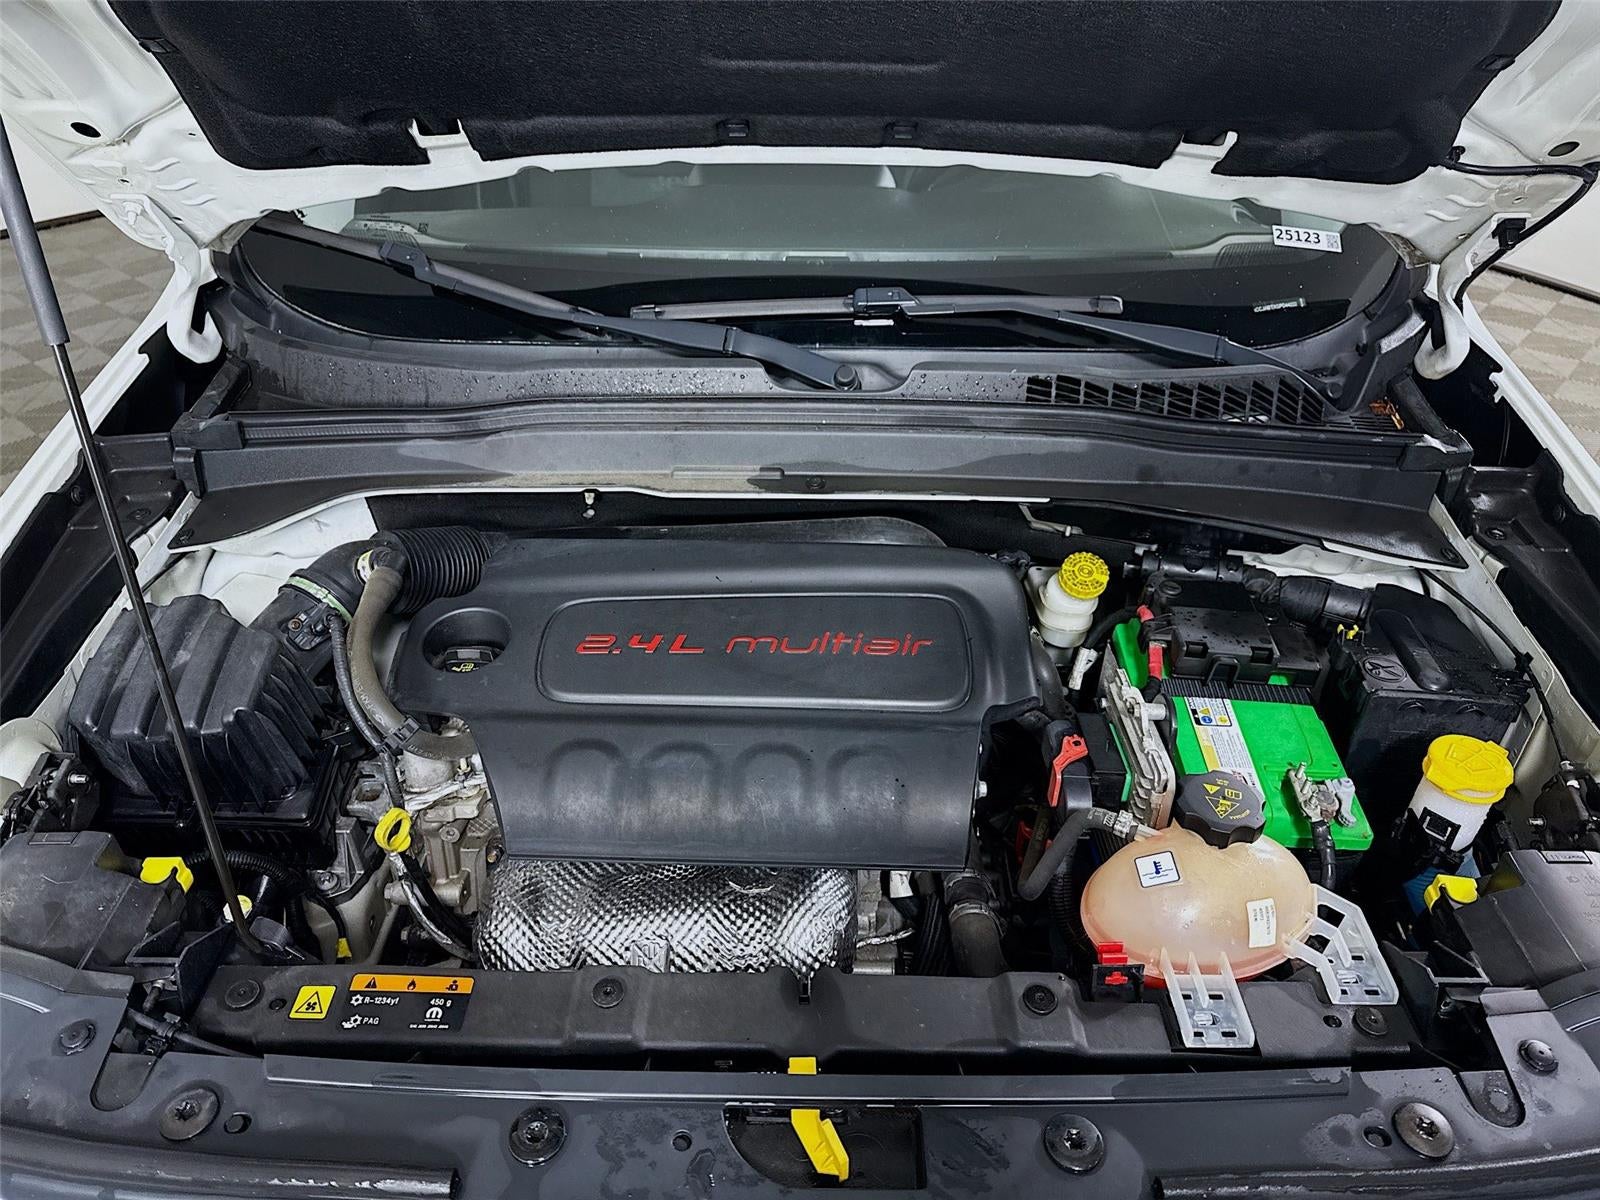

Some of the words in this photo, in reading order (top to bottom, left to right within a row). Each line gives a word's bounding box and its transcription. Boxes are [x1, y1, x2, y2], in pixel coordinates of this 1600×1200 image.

[1274, 228, 1321, 244] 25123
[575, 633, 705, 655] 2.4L
[725, 631, 934, 656] multiair
[363, 996, 400, 1006] R-1234yf
[430, 998, 445, 1006] 450
[362, 1017, 380, 1025] PAG
